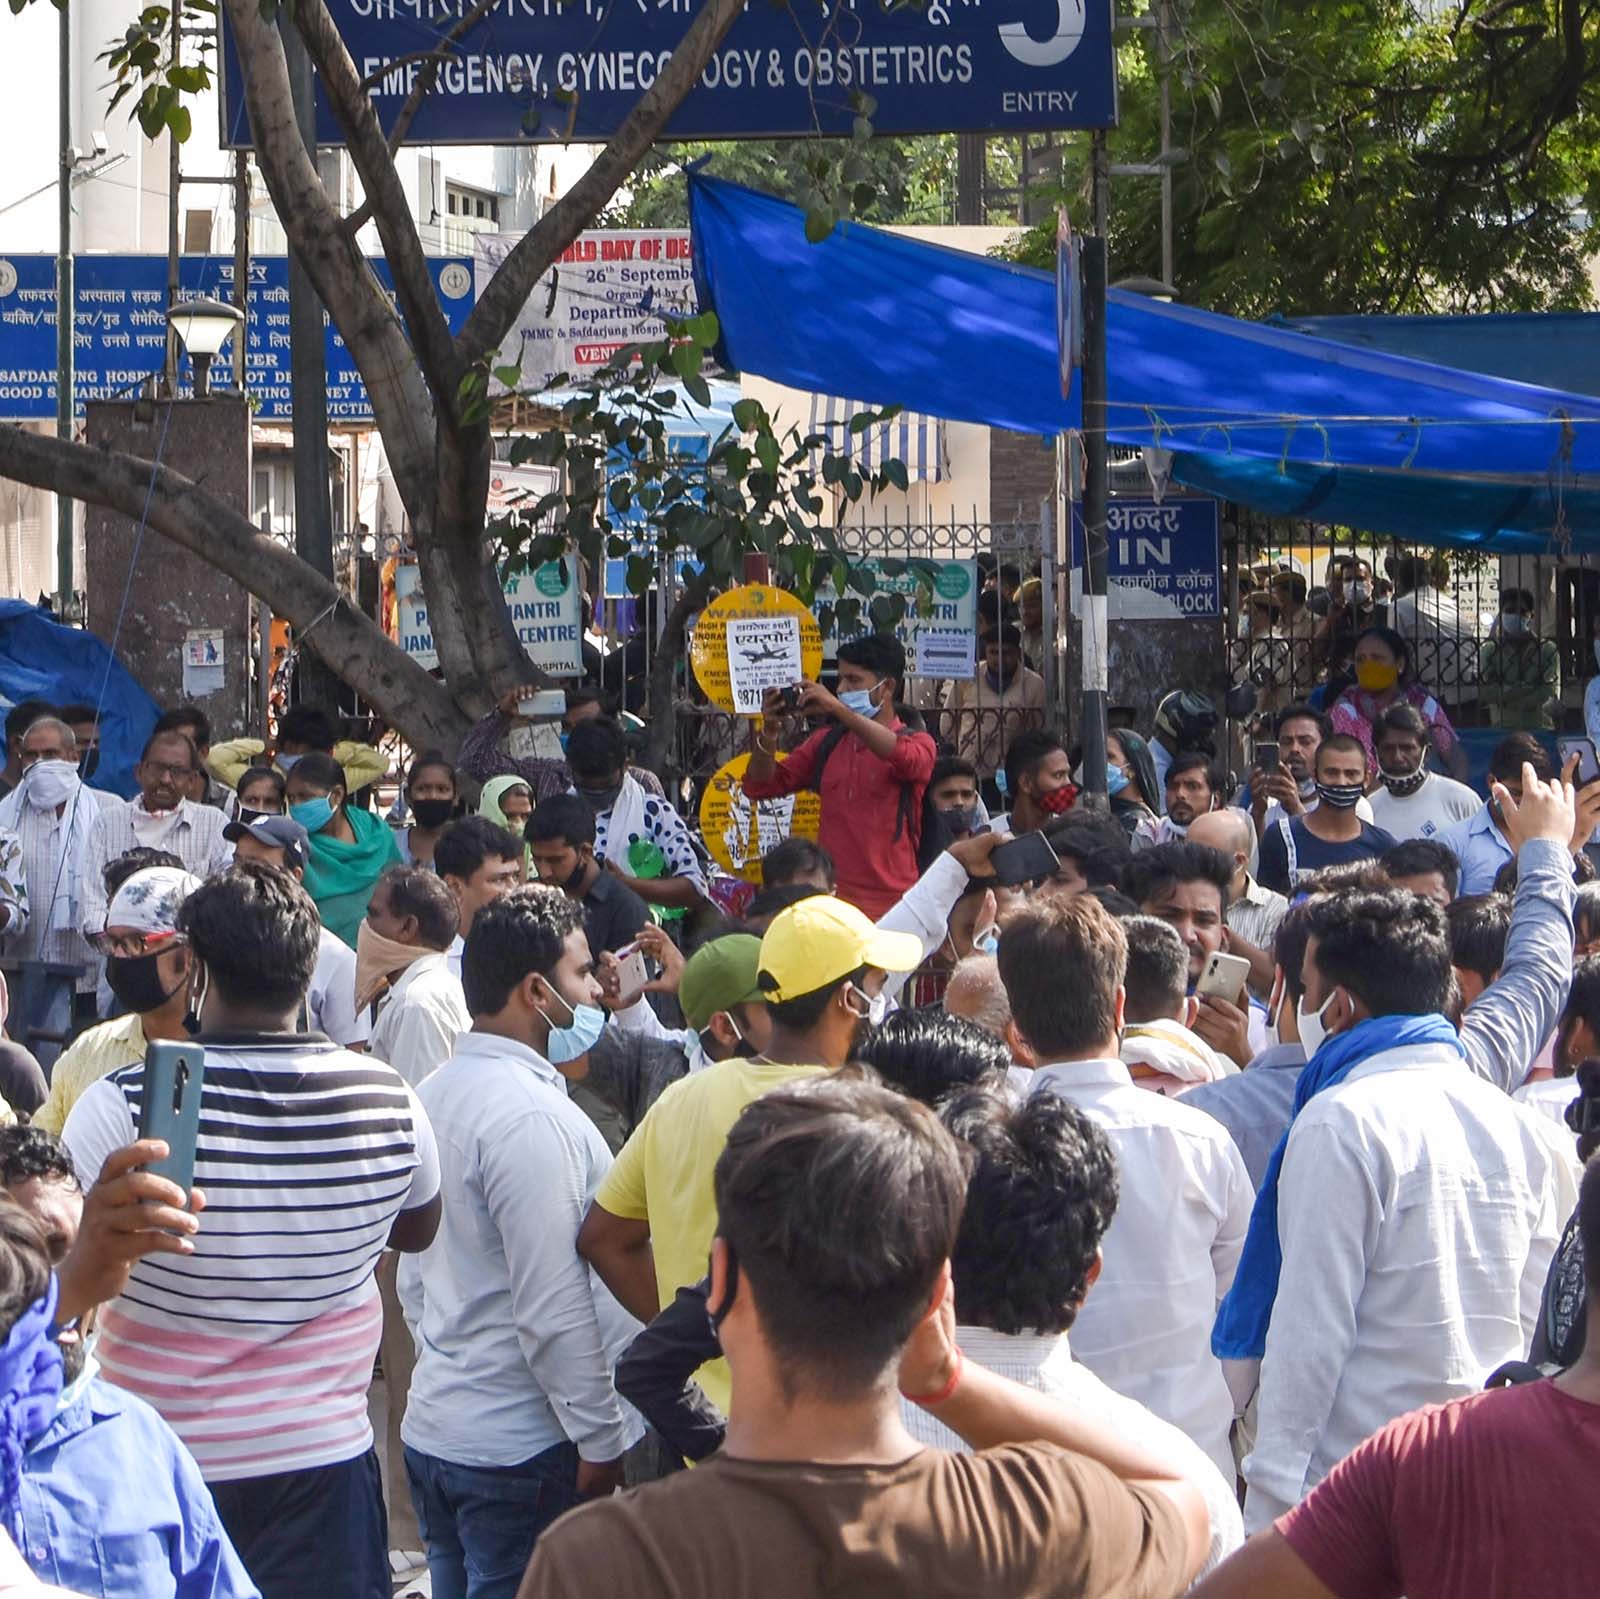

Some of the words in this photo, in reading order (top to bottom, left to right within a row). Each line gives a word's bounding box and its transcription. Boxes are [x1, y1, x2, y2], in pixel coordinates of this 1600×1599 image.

[767, 51, 786, 88] &
[794, 44, 974, 87] OBSTETRICS
[1002, 90, 1080, 113] ENTRY
[600, 239, 636, 262] DAY
[639, 238, 662, 261] OF
[568, 325, 628, 340] Safdarjung
[0, 386, 43, 399] GOOD
[1106, 506, 1182, 532] अन्दर
[1118, 538, 1171, 565] IN
[1176, 568, 1214, 590] ब्लॉक
[518, 625, 578, 644] CENTRE
[735, 630, 796, 647] एयरपोर्ट
